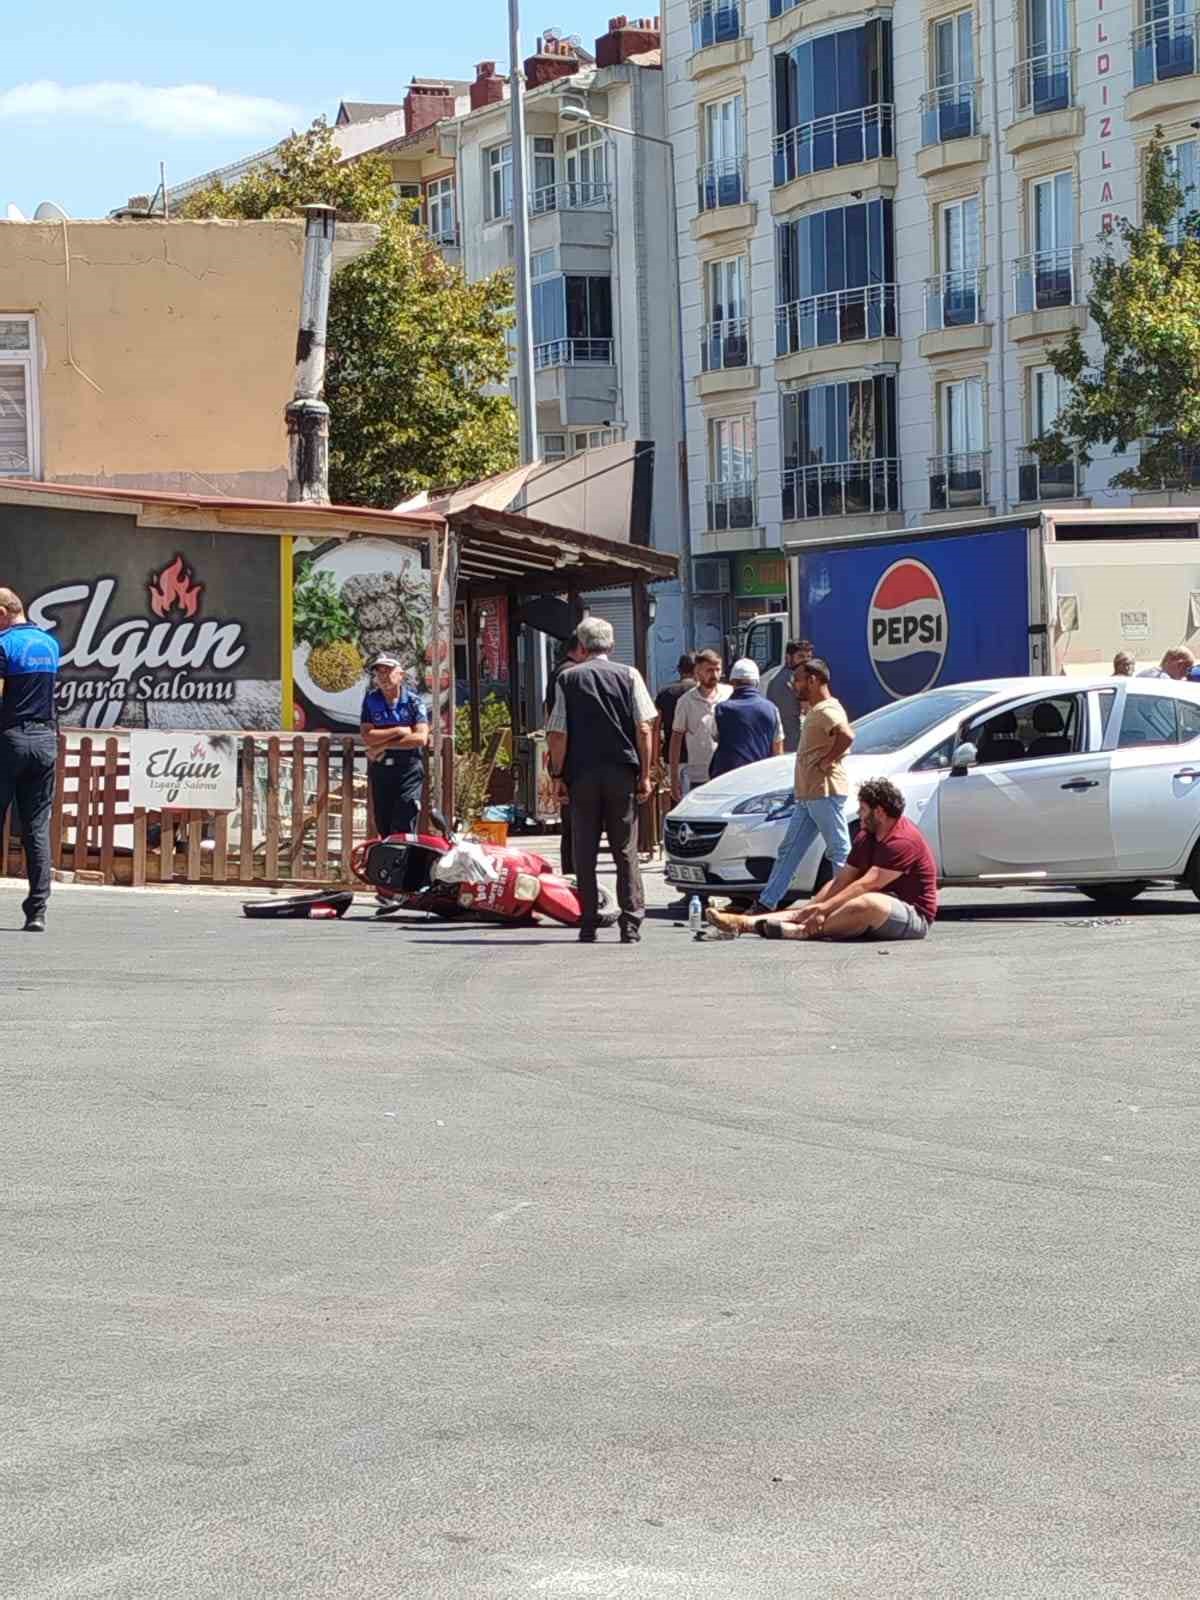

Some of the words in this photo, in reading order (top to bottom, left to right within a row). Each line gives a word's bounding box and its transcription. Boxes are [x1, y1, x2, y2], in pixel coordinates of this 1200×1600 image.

[872, 614, 942, 646] PEPSI
[53, 679, 125, 711] zgara
[136, 671, 234, 700] Salonu
